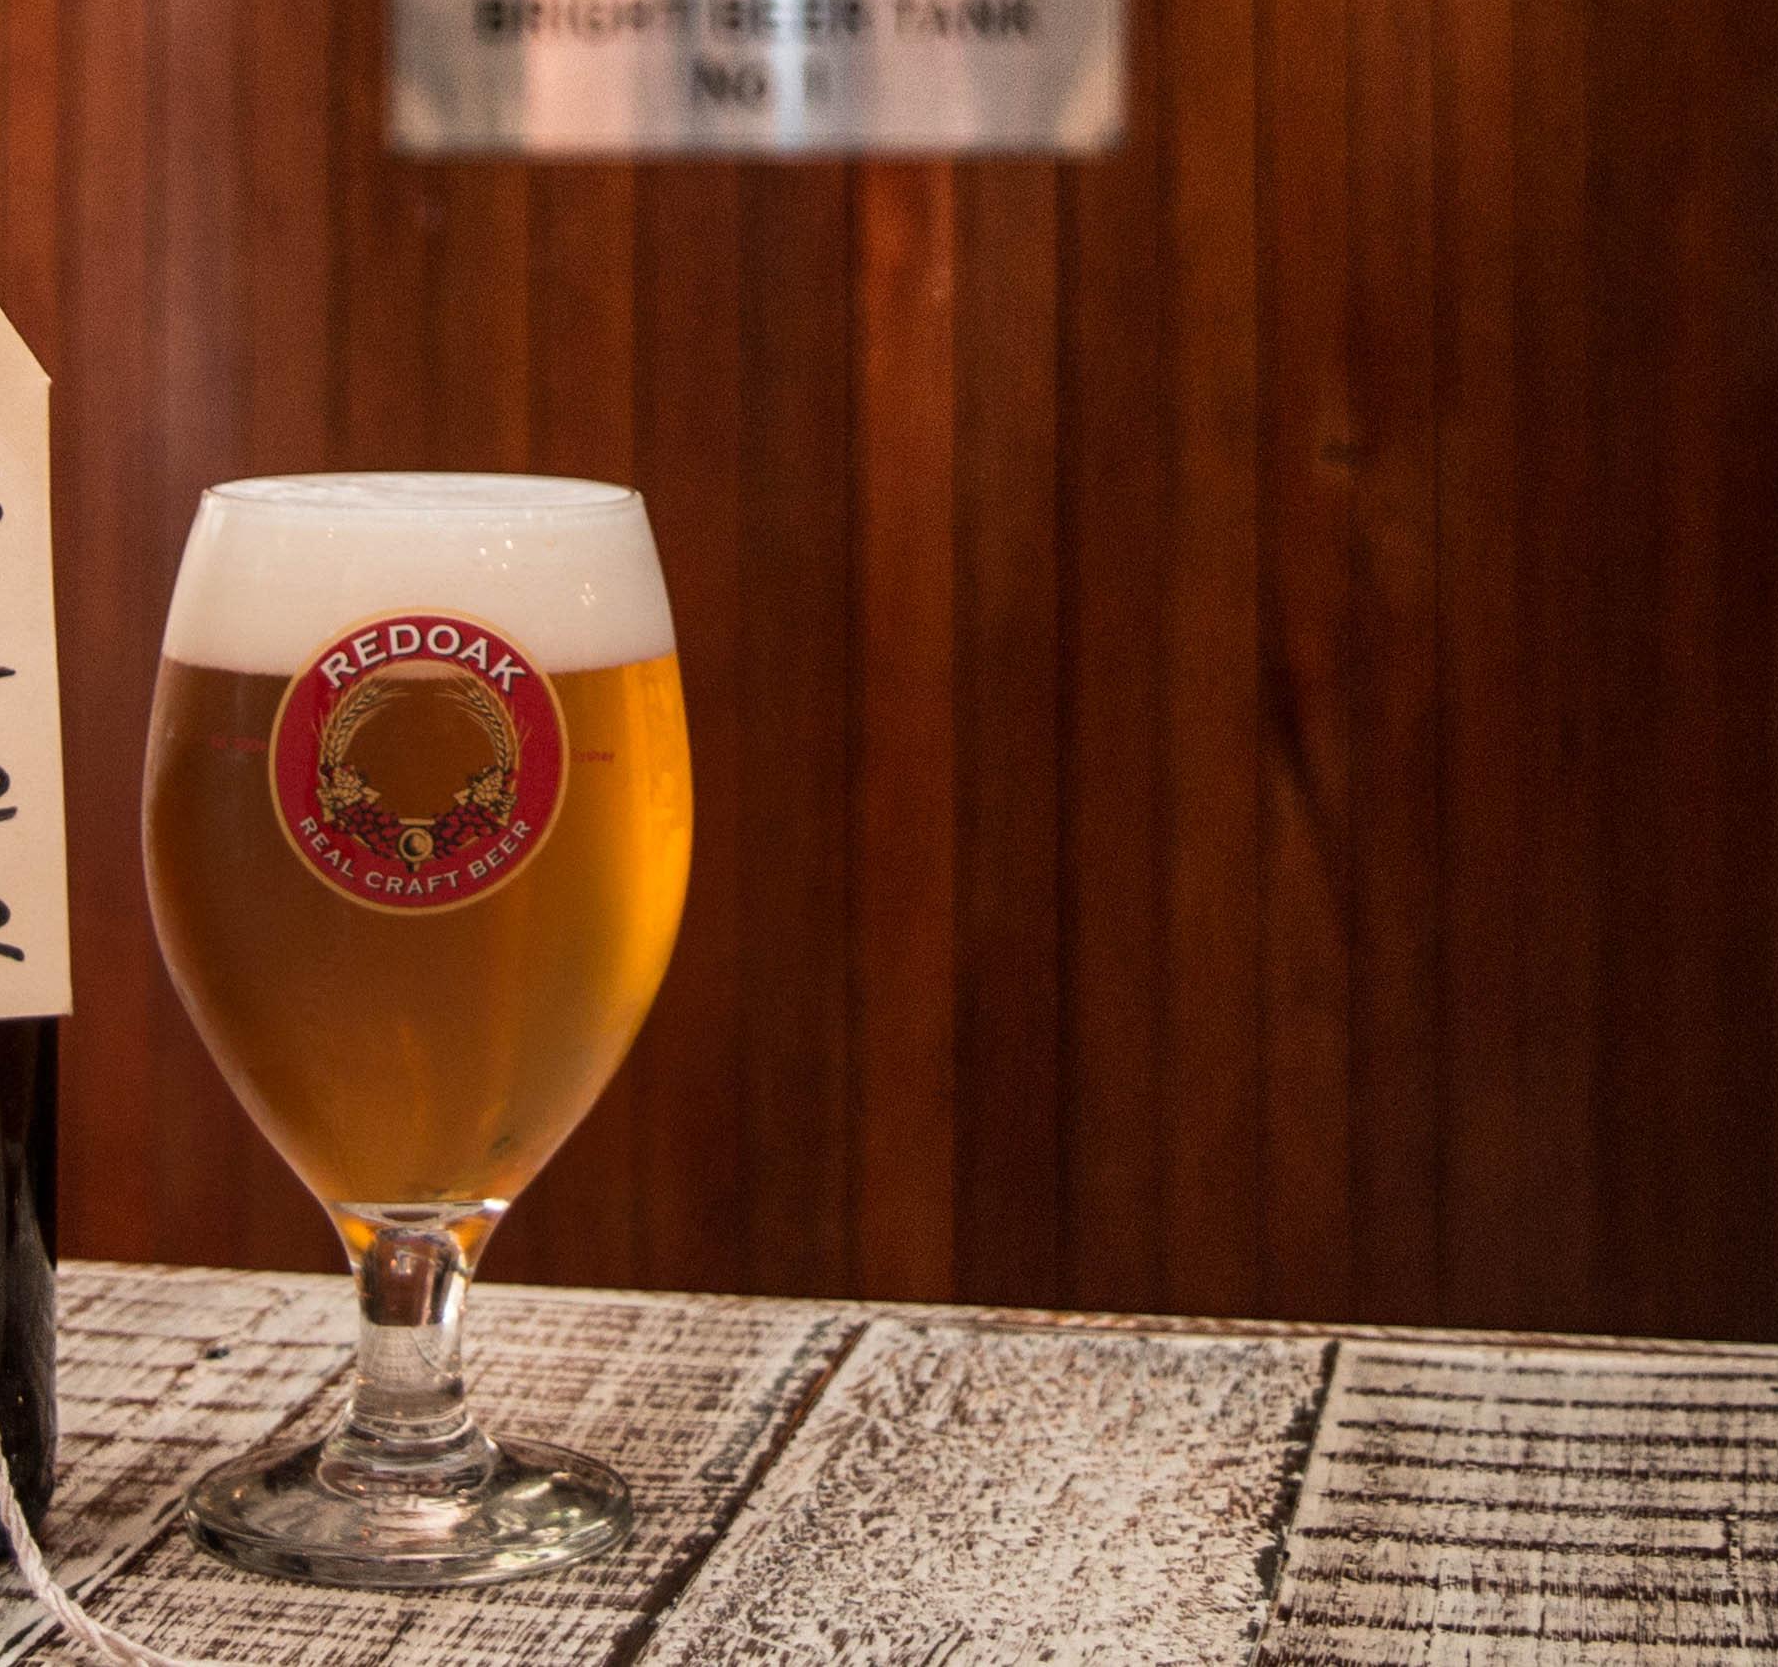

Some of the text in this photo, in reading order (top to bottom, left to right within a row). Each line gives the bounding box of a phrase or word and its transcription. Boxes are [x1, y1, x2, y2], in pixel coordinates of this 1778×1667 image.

[319, 623, 525, 693] REDOAK
[298, 815, 532, 896] REAL CRAFT BEER
